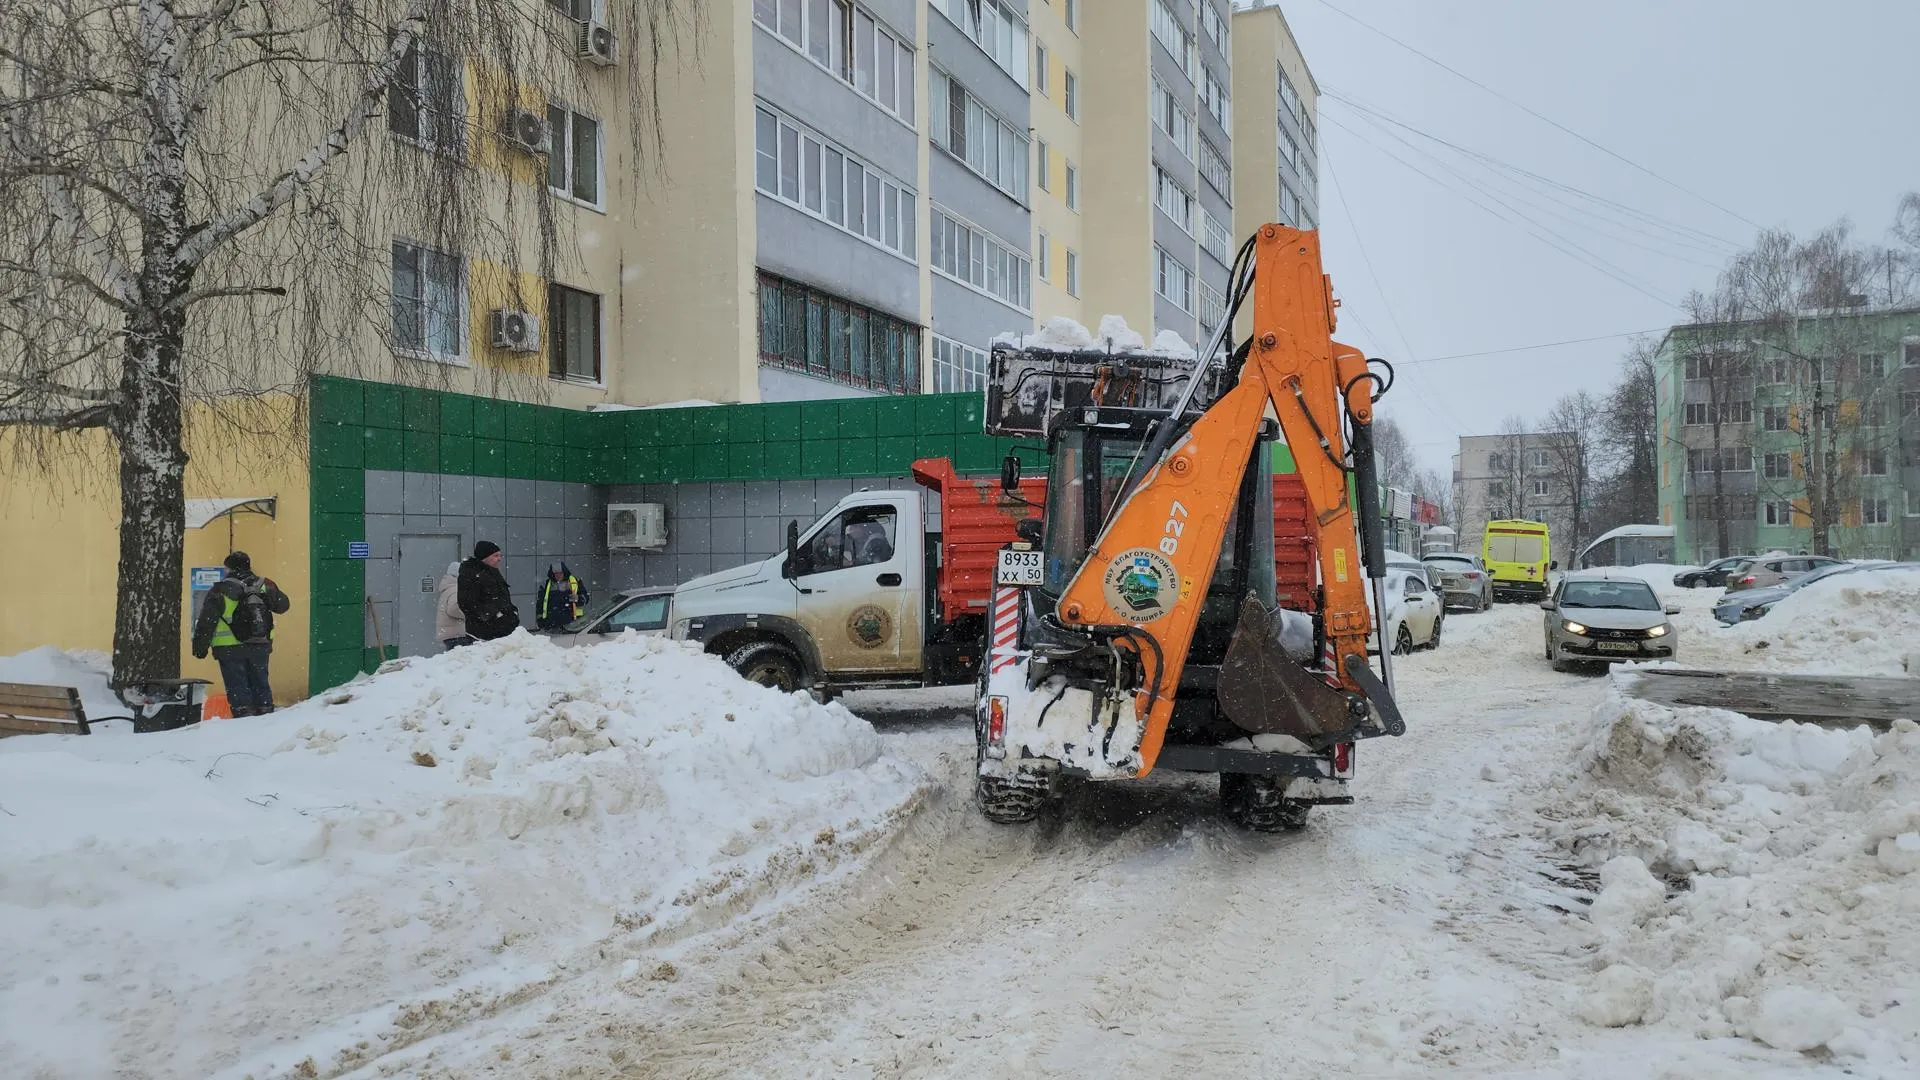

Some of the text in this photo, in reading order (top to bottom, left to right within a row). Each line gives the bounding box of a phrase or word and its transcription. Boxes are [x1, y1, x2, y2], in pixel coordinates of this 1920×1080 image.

[1159, 500, 1188, 556] 827
[1004, 552, 1039, 566] 8933
[1027, 569, 1041, 579] 50
[1105, 567, 1115, 585] МБУ
[1130, 610, 1164, 622] КАШИРА
